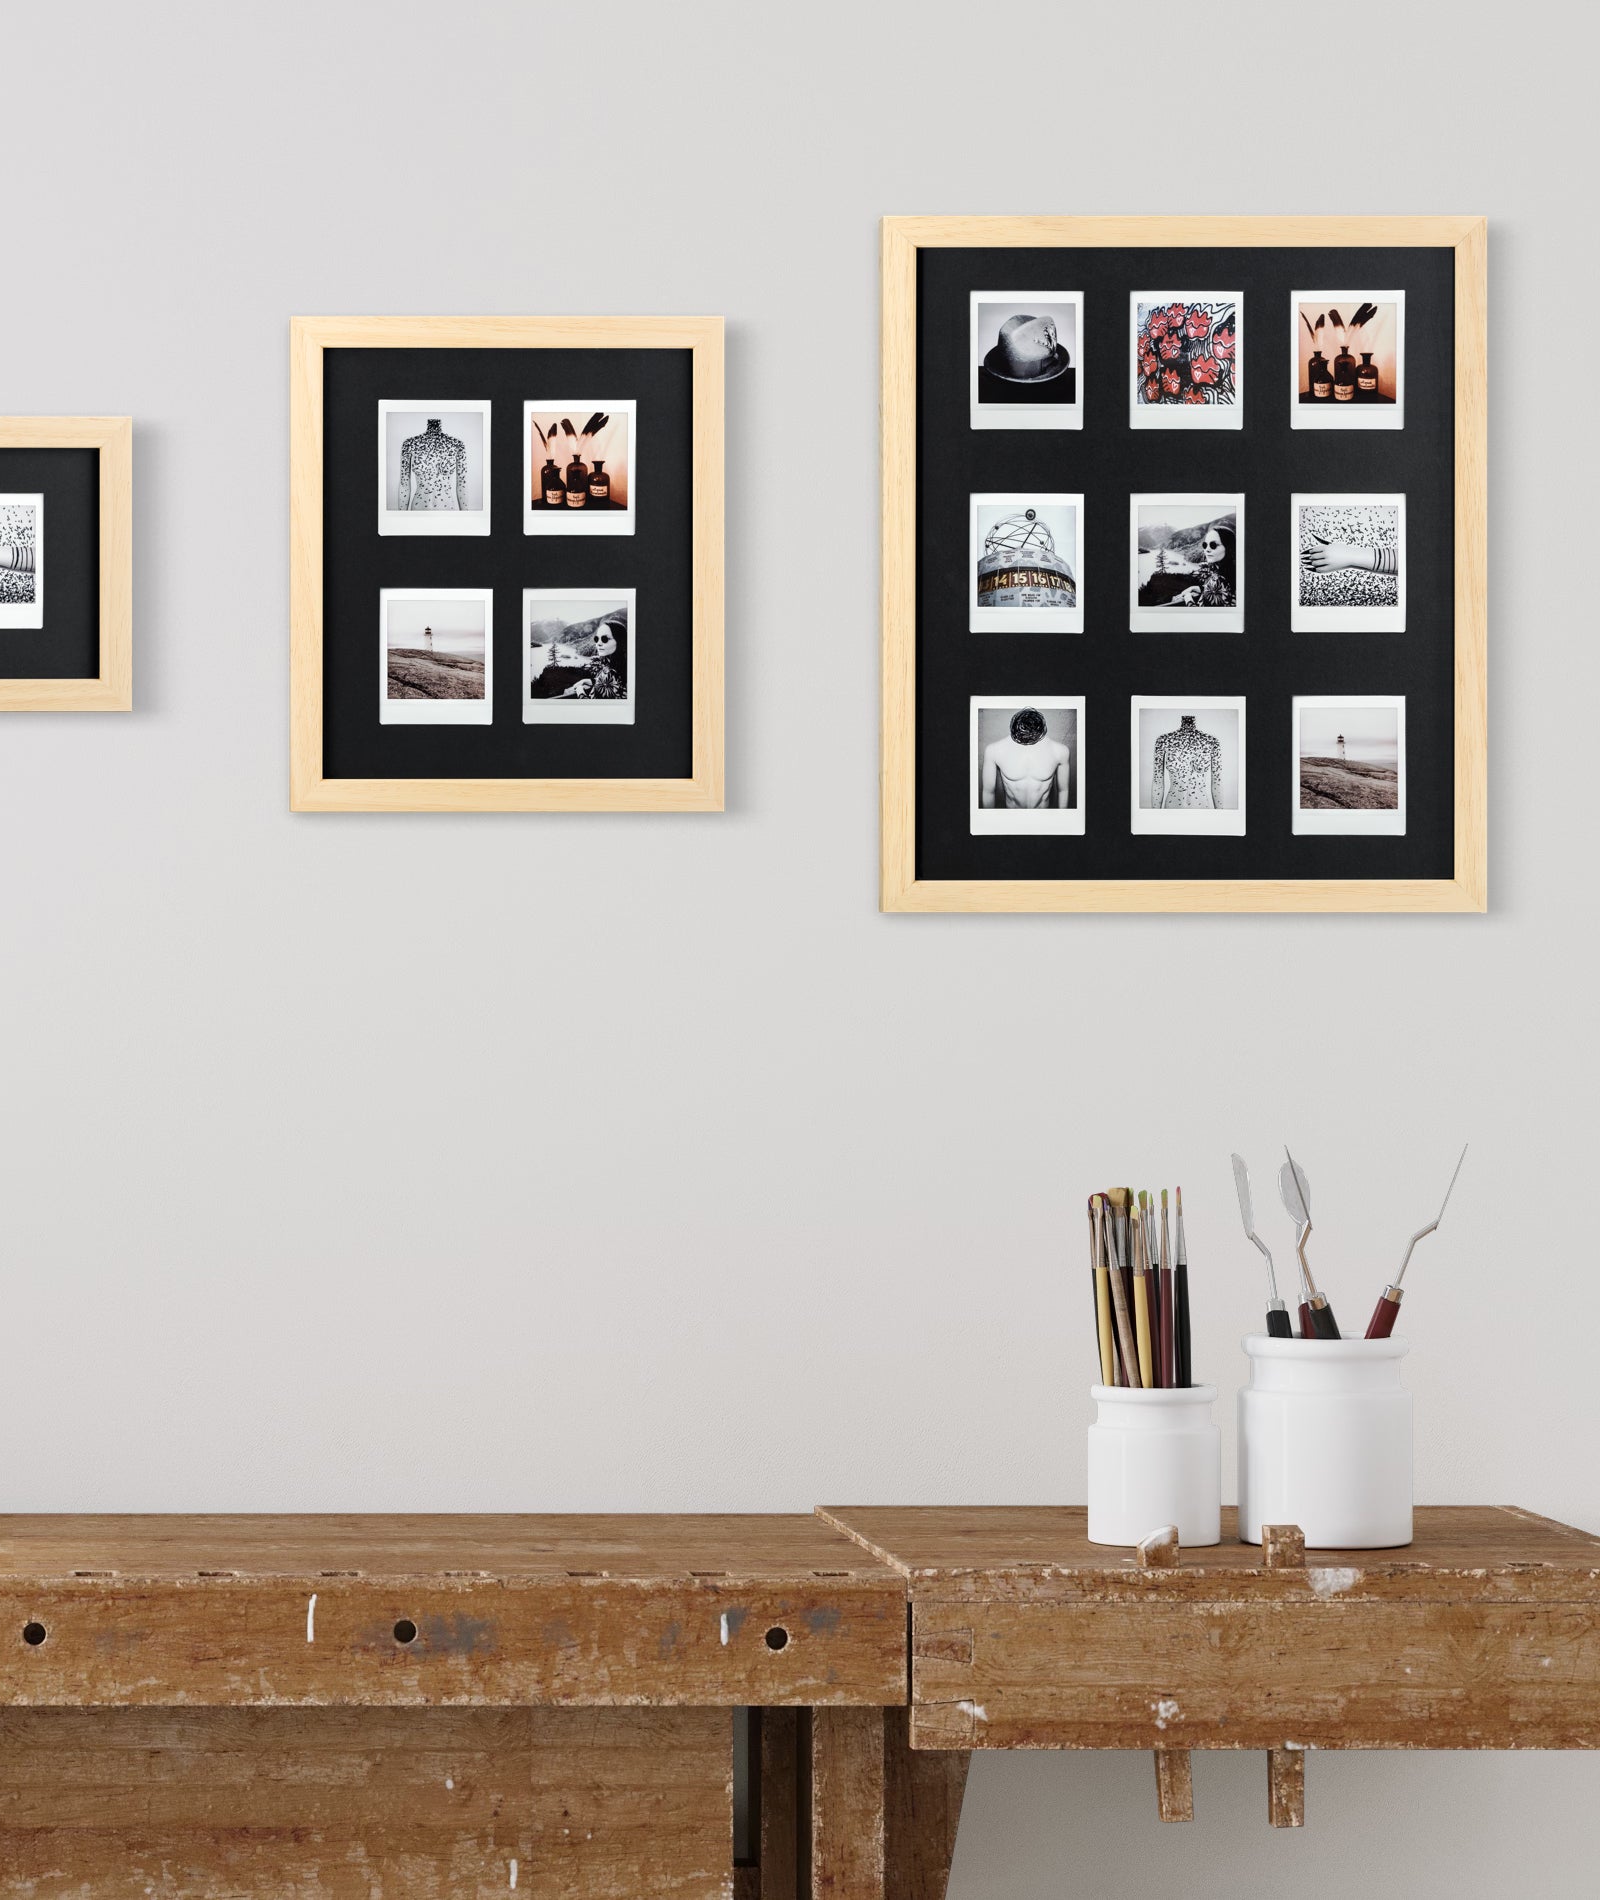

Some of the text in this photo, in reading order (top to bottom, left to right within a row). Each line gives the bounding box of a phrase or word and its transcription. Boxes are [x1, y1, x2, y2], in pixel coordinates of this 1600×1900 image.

[994, 574, 1007, 587] 14
[1013, 573, 1027, 584] 15
[1032, 572, 1047, 584] 16
[1049, 575, 1061, 587] 17
